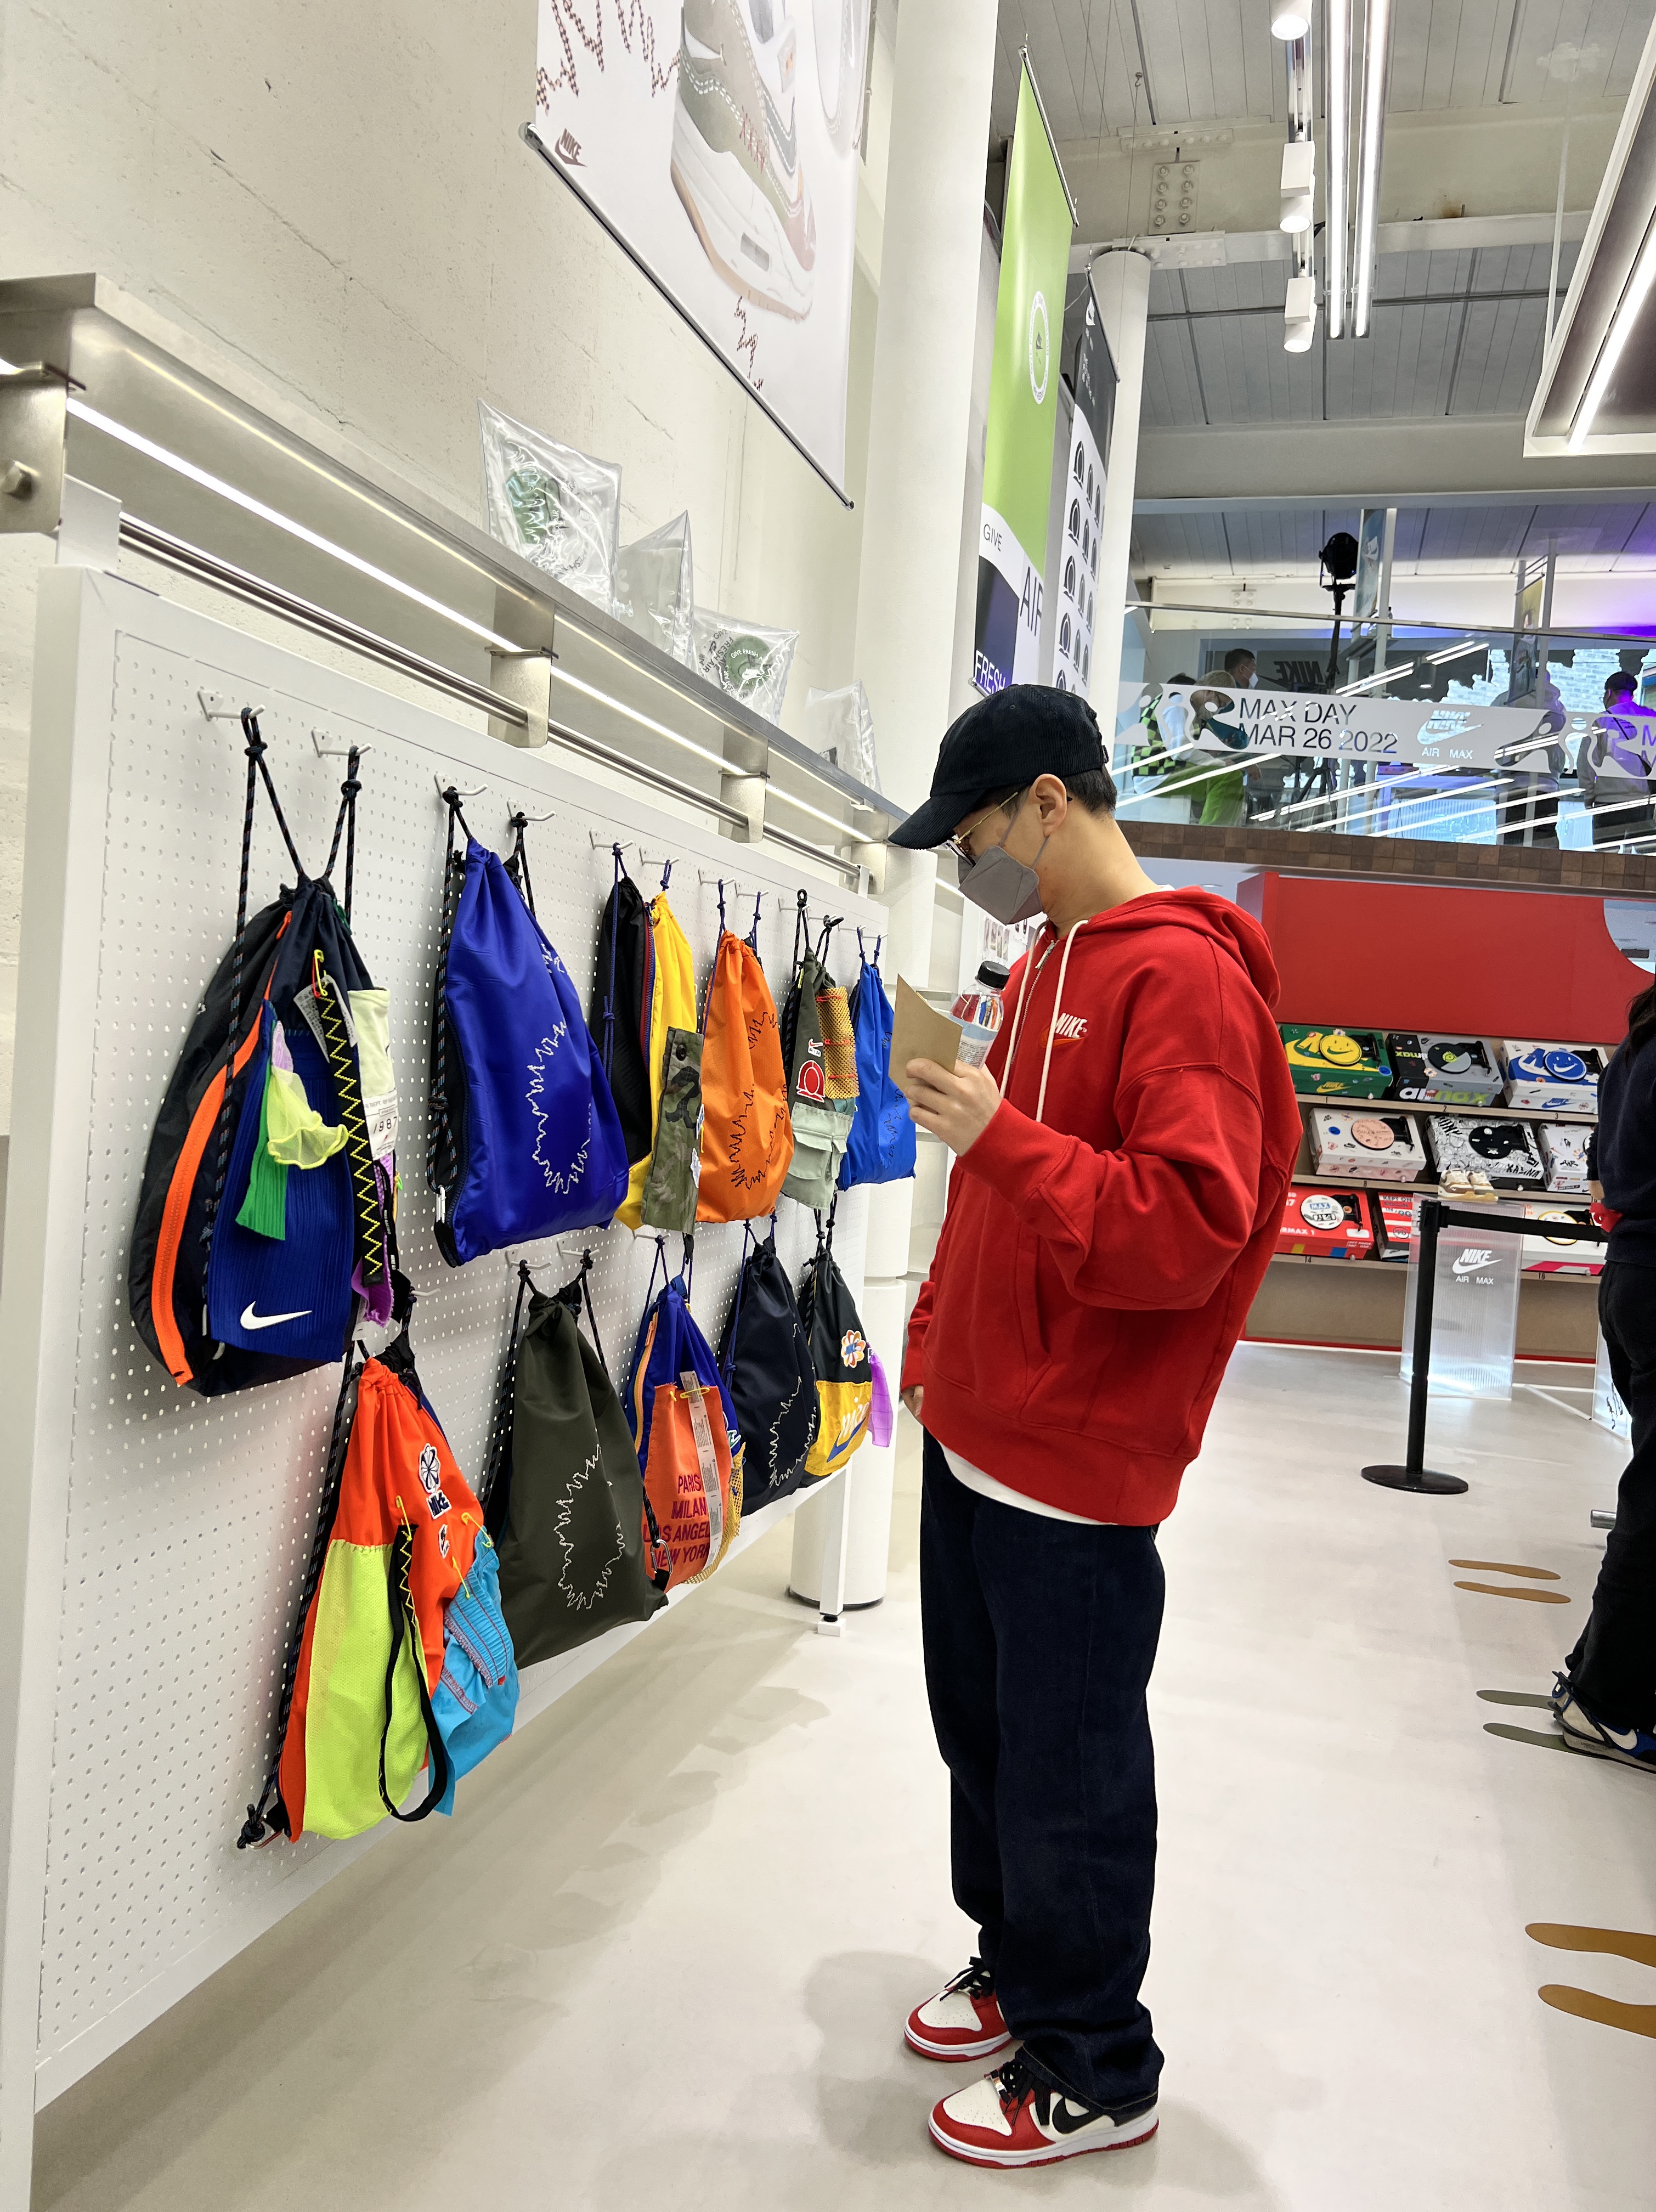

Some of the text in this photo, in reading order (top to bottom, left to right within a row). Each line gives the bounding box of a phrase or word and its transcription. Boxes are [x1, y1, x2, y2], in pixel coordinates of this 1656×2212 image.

[560, 128, 581, 158] NIKE
[983, 523, 1002, 551] GIVE
[731, 649, 759, 658] GIVE FRESH
[1240, 698, 1357, 726] MAX DAY
[1427, 710, 1471, 731] NIKE
[1239, 723, 1397, 754] MAR 26 2022
[1421, 747, 1473, 760] AIR MAX
[1055, 1012, 1088, 1039] NIKE
[373, 1116, 397, 1135] 1987
[1460, 1249, 1492, 1263] NIKE
[1476, 1277, 1494, 1285] MAX
[677, 1474, 702, 1494] PARIS
[671, 1497, 707, 1520] MILAN
